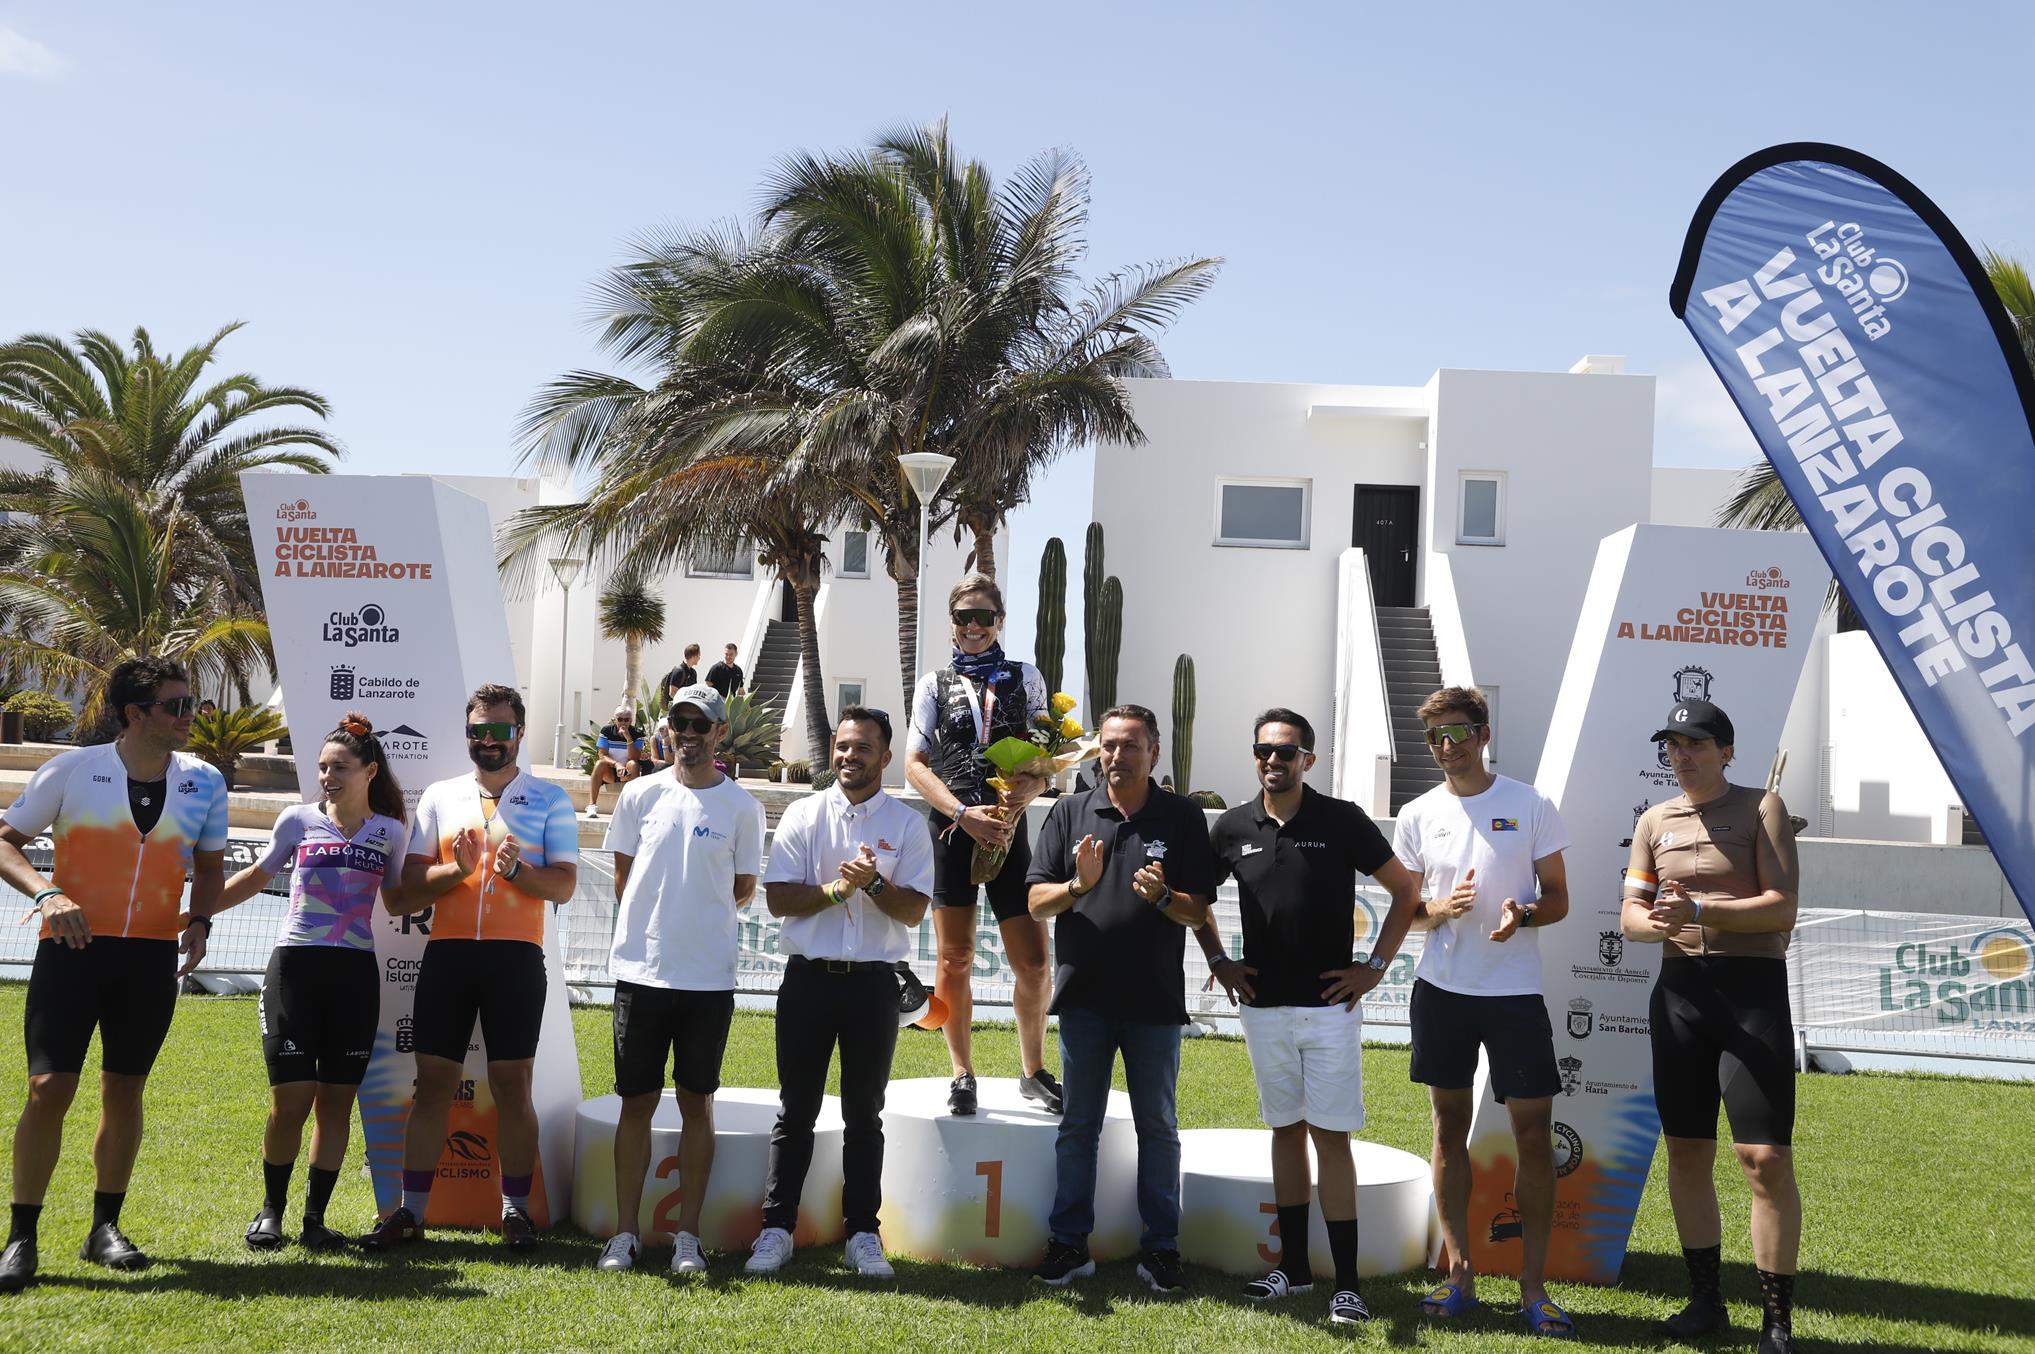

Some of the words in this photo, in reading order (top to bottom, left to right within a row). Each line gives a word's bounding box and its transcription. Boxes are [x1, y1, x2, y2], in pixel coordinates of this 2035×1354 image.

[1837, 222, 1877, 268] Club
[1701, 278, 1762, 335] A
[1735, 327, 1968, 688] LANZAROTE
[1752, 246, 1905, 470] VUELTA
[1878, 467, 2035, 738] CICLISTA
[280, 503, 296, 511] Club
[276, 527, 358, 544] VUELTA
[275, 544, 377, 562] CICLISTA
[274, 561, 292, 577] A
[296, 562, 432, 580] LANZAROTE
[1750, 570, 1767, 579] Club
[1700, 591, 1788, 613] VUELTA
[330, 612, 359, 626] Club
[1676, 608, 1787, 631] CICLISTA
[1617, 622, 1635, 639] A
[1640, 623, 1787, 649] LANZAROTE
[358, 676, 402, 687] Cabildo
[405, 678, 420, 688] de
[358, 688, 416, 699] Lanzarote
[382, 741, 428, 751] AROTE
[1639, 770, 1677, 780] Ayuntam
[306, 846, 385, 865] LABORAL
[386, 957, 423, 971] Cana
[1895, 942, 1970, 977] Club
[385, 970, 420, 983] Islan
[1599, 1013, 1650, 1025] Ayuntamie
[1599, 1024, 1616, 1033] San
[1618, 1025, 1652, 1035] Bartolo
[1585, 1080, 1629, 1090] Ayuntamiento
[435, 1168, 490, 1179] ICLISMO
[976, 1160, 1003, 1238] 1
